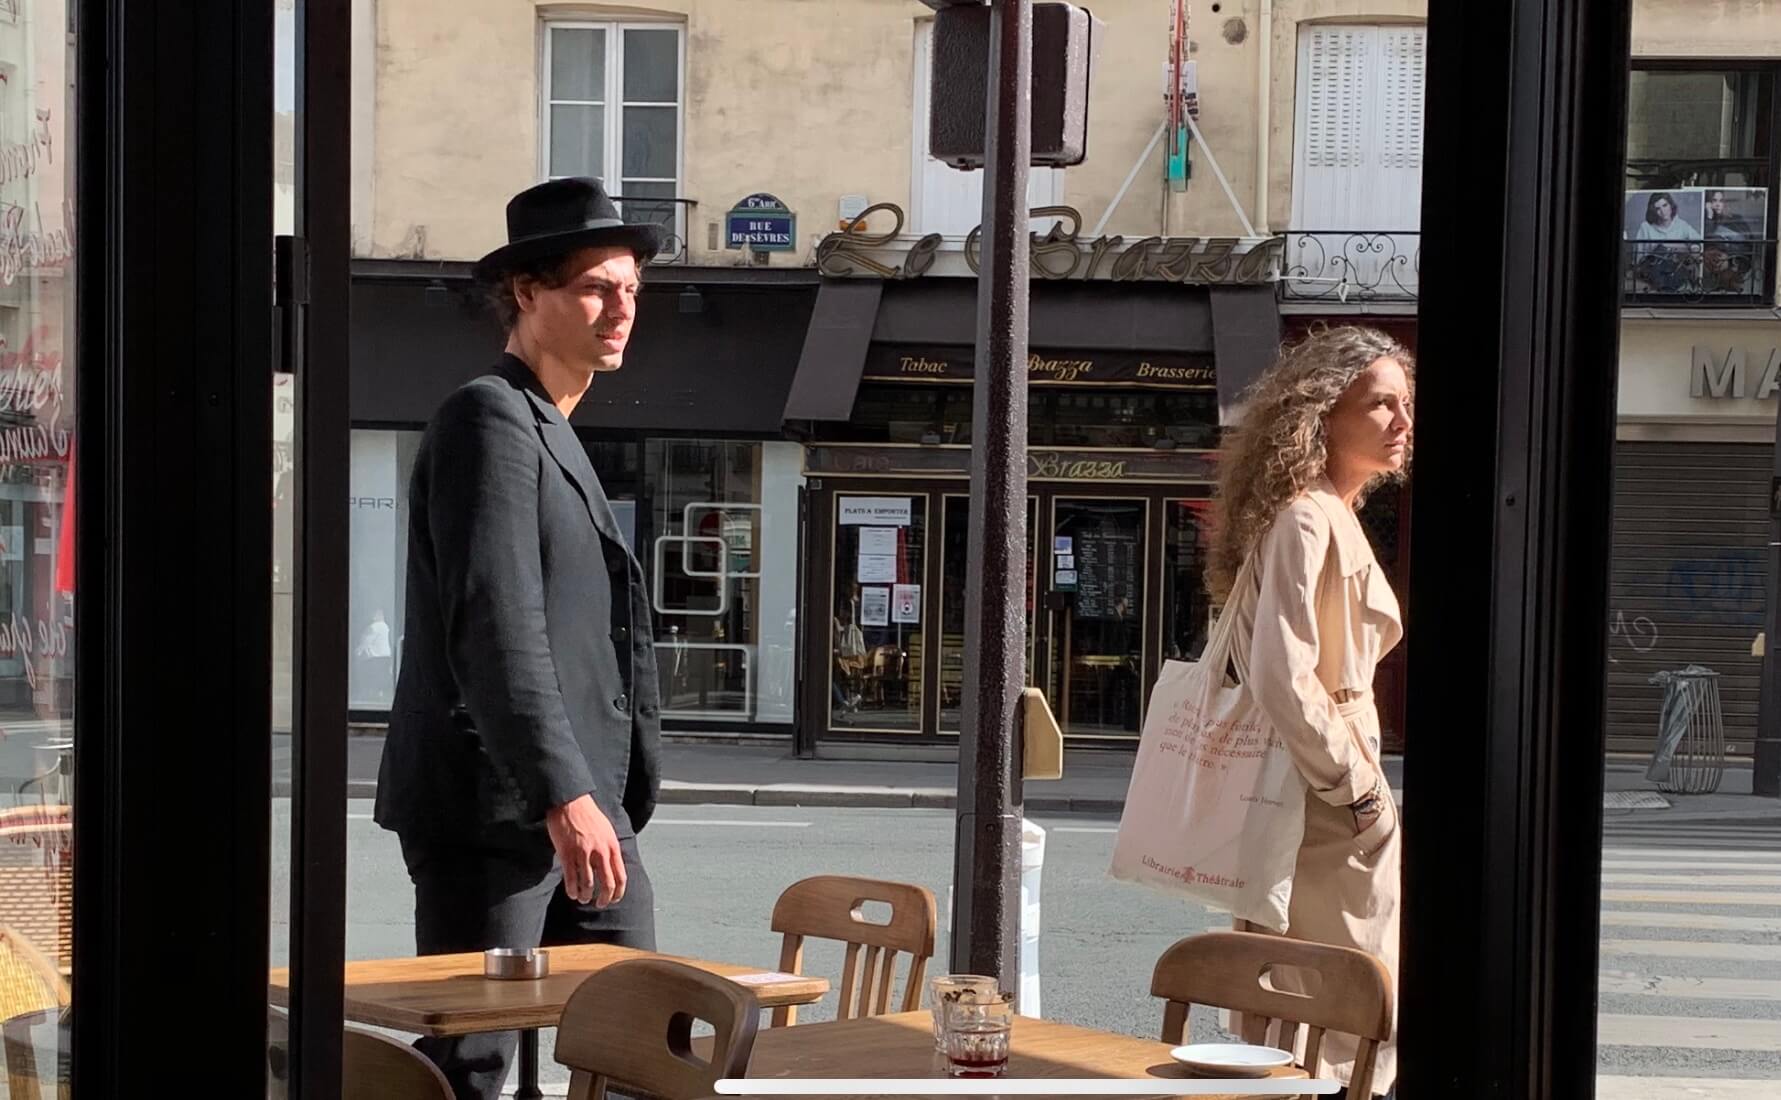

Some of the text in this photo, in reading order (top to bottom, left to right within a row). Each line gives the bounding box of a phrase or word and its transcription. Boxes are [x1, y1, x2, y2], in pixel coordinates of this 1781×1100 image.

[749, 221, 772, 231] RUE
[750, 231, 790, 243] SÈVRES
[816, 202, 942, 280] Le
[900, 357, 947, 373] Tabac
[1028, 353, 1093, 380] Brazza
[1136, 361, 1216, 380] Brasserie
[844, 507, 865, 515] PLATS
[1219, 733, 1232, 744] de
[1233, 736, 1259, 748] plus
[1142, 854, 1246, 889] Librairie Théâtrale
